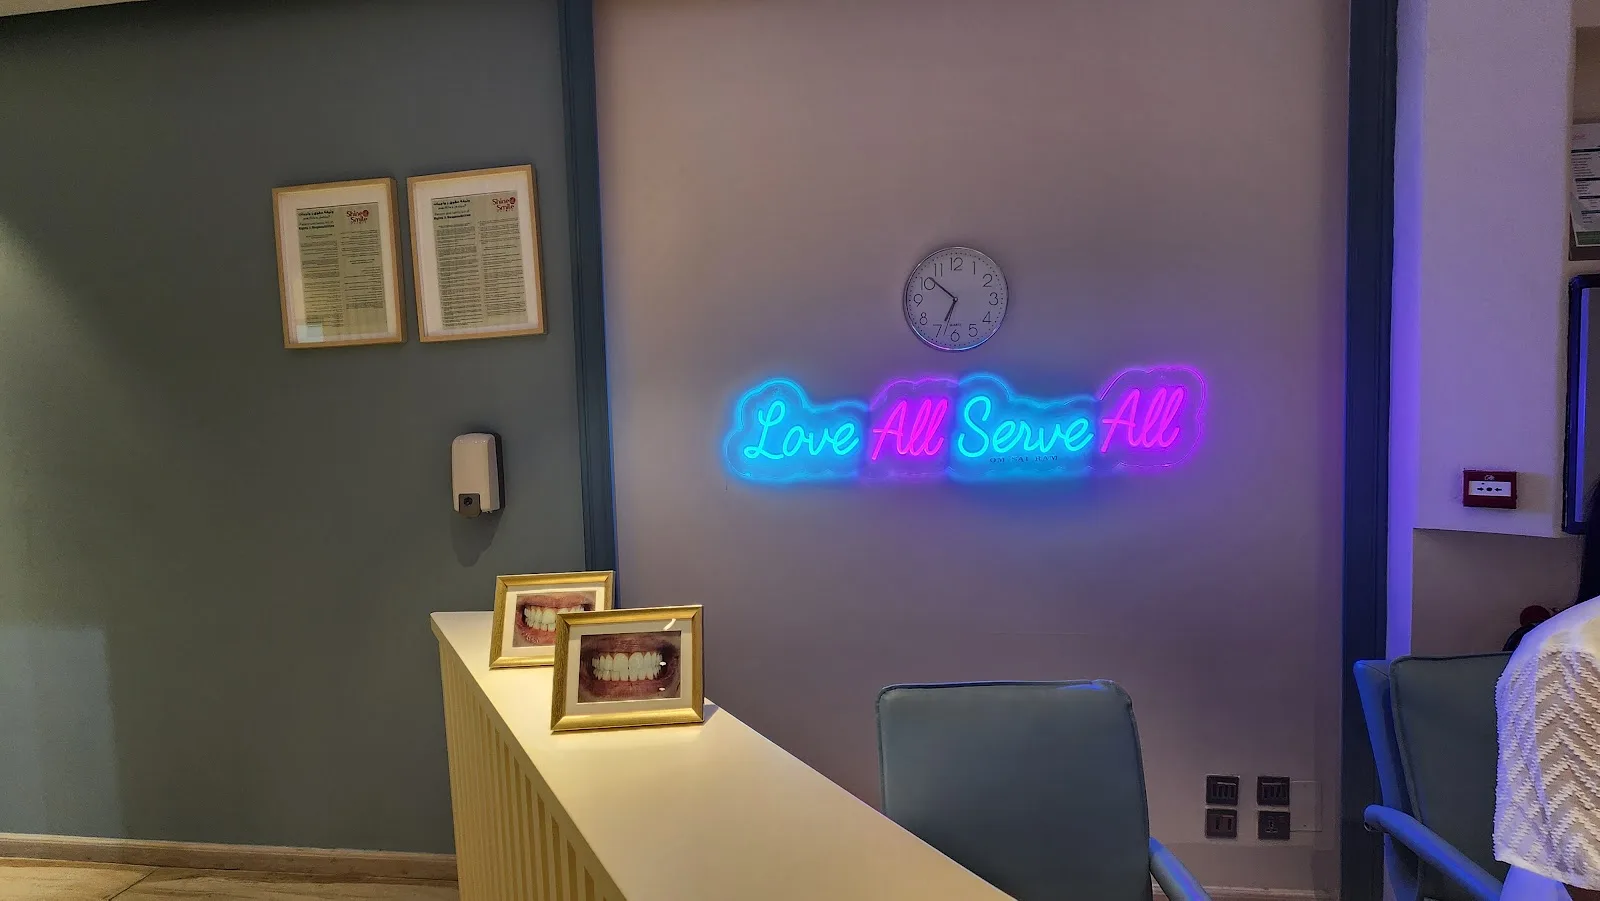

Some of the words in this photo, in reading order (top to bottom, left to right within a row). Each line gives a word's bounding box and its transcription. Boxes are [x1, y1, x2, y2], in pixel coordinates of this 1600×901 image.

[934, 263, 943, 277] 11
[950, 257, 964, 271] 12
[972, 260, 976, 275] 1
[920, 276, 936, 291] 10
[982, 273, 993, 288] 2
[913, 293, 923, 308] 9
[988, 292, 999, 306] 3
[919, 311, 928, 326] 8
[982, 311, 992, 323] 4
[932, 324, 943, 338] 7
[950, 328, 960, 342] 6
[968, 323, 979, 338] 5
[743, 400, 860, 461] Love
[871, 398, 949, 461] All
[957, 395, 1094, 458] Serve
[1101, 386, 1184, 453] All
